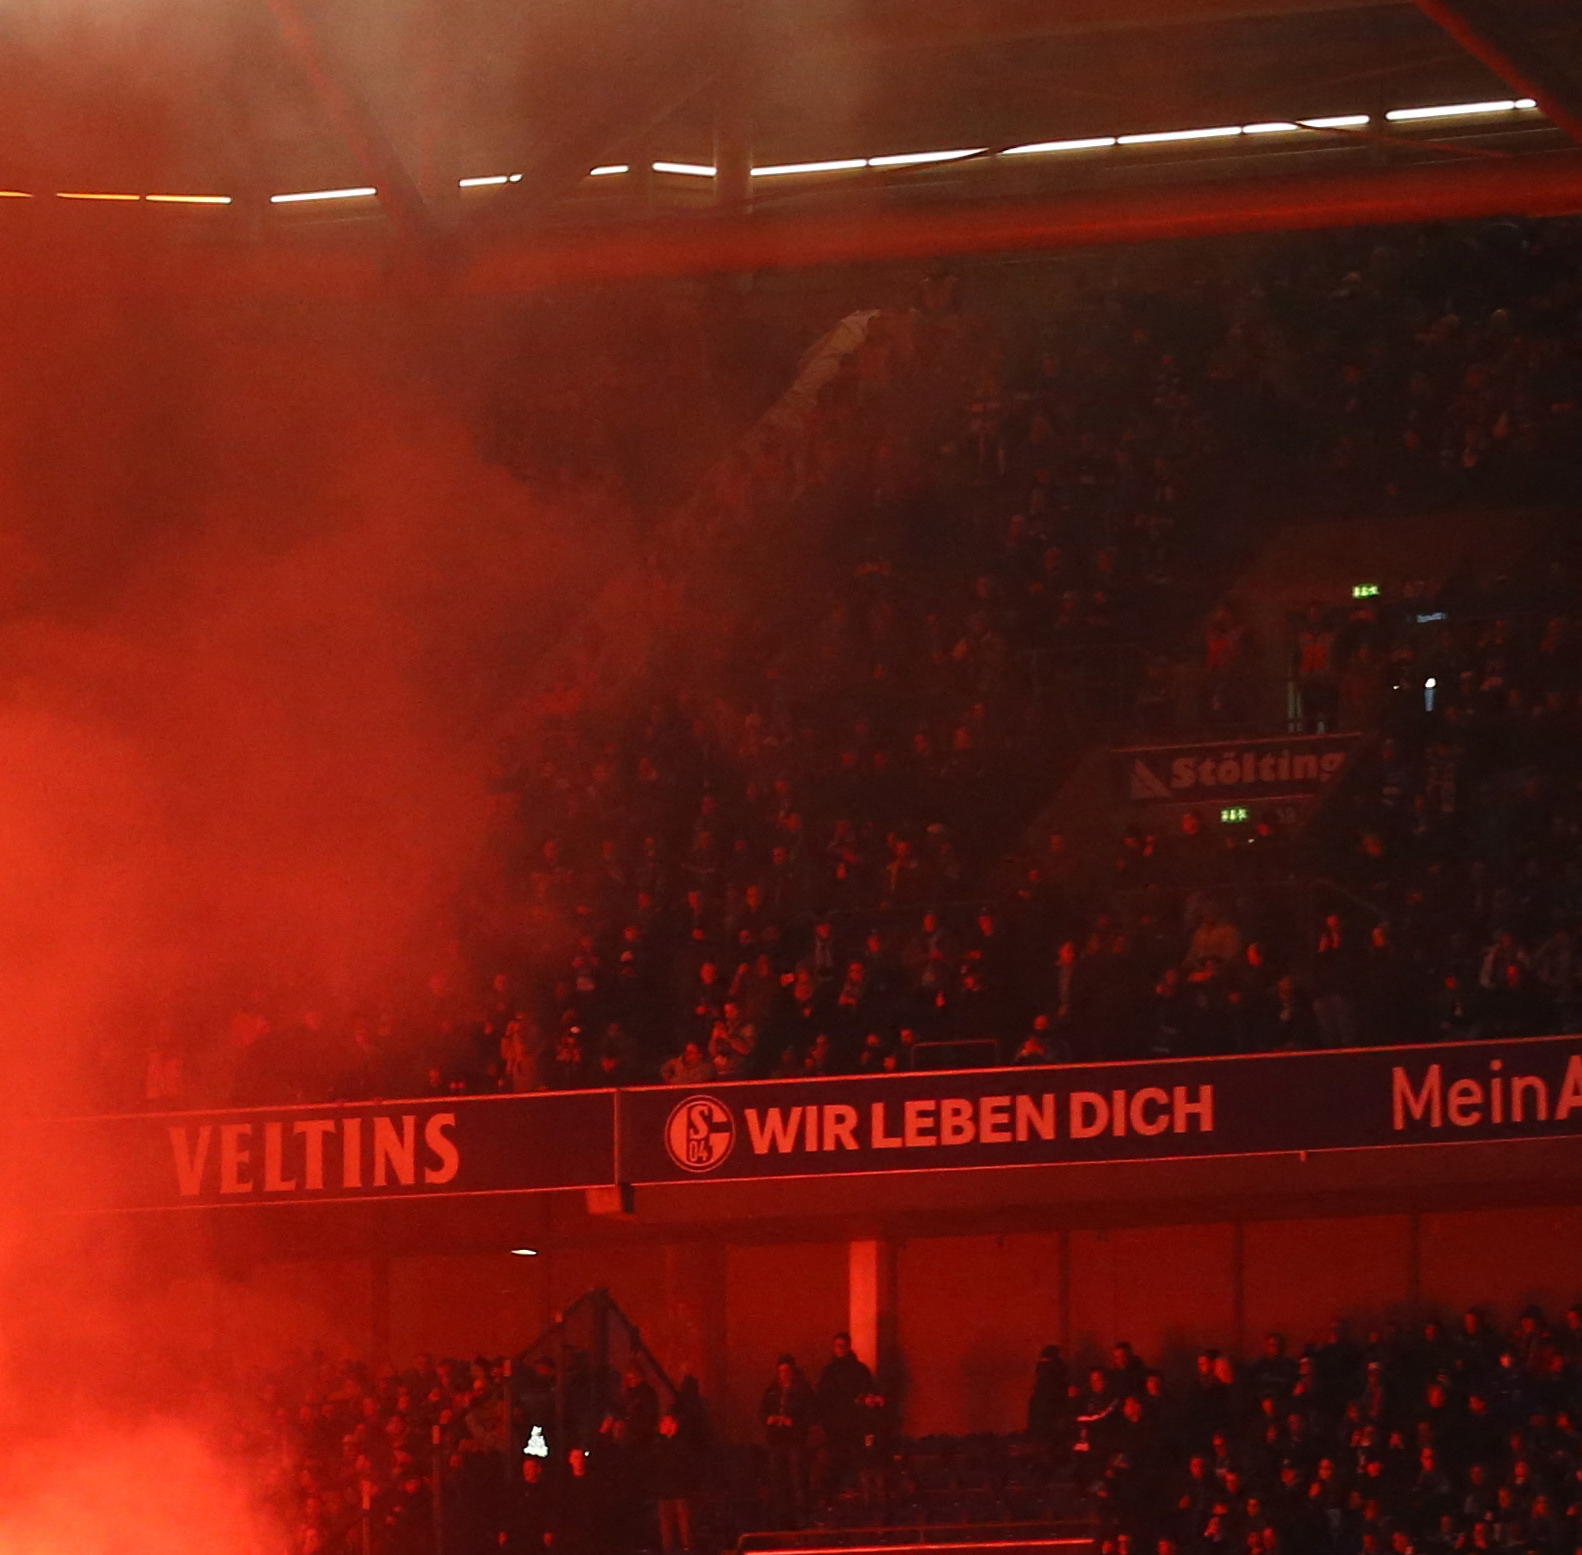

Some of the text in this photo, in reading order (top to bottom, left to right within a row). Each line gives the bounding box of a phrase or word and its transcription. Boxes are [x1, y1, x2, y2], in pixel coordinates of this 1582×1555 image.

[1170, 751, 1347, 790] Stölting
[169, 1112, 461, 1197] VELTINS
[744, 1085, 1214, 1155] WIR LEBEN DICH
